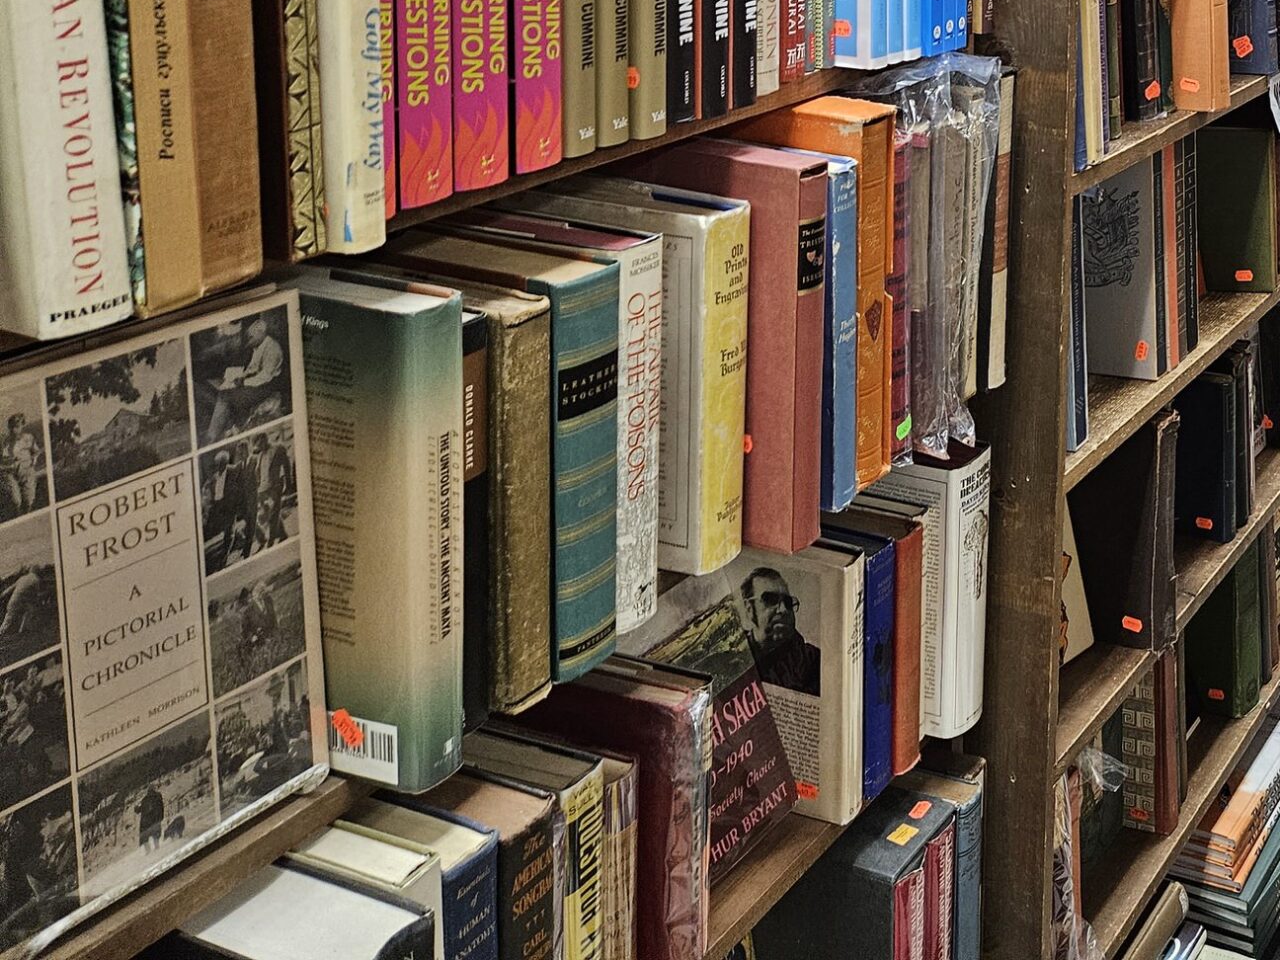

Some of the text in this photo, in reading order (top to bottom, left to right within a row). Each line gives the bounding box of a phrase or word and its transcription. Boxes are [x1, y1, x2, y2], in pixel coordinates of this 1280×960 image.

[580, 1, 594, 71] CUMMINE
[157, 87, 175, 161] Росписи
[579, 127, 595, 141] Yale
[56, 55, 105, 296] REVOLUTION
[729, 273, 744, 288] and
[731, 243, 744, 258] Old
[49, 292, 131, 324] PRAEGER
[626, 291, 646, 501] OF THE POISONS
[464, 383, 474, 470] DONALD CLARKE
[68, 472, 186, 537] ROBERT
[83, 511, 177, 568] FROST
[439, 431, 451, 640] THE UNTOLD STORY ANCIENT MAYA
[128, 583, 143, 602] A
[82, 597, 190, 657] PICTORIAL
[80, 626, 198, 693] CHRONICLE
[84, 687, 200, 750] KATHLEEN MORRISON
[723, 681, 767, 737] SAGA
[746, 755, 778, 791] Choice
[742, 781, 790, 836] BRYANT
